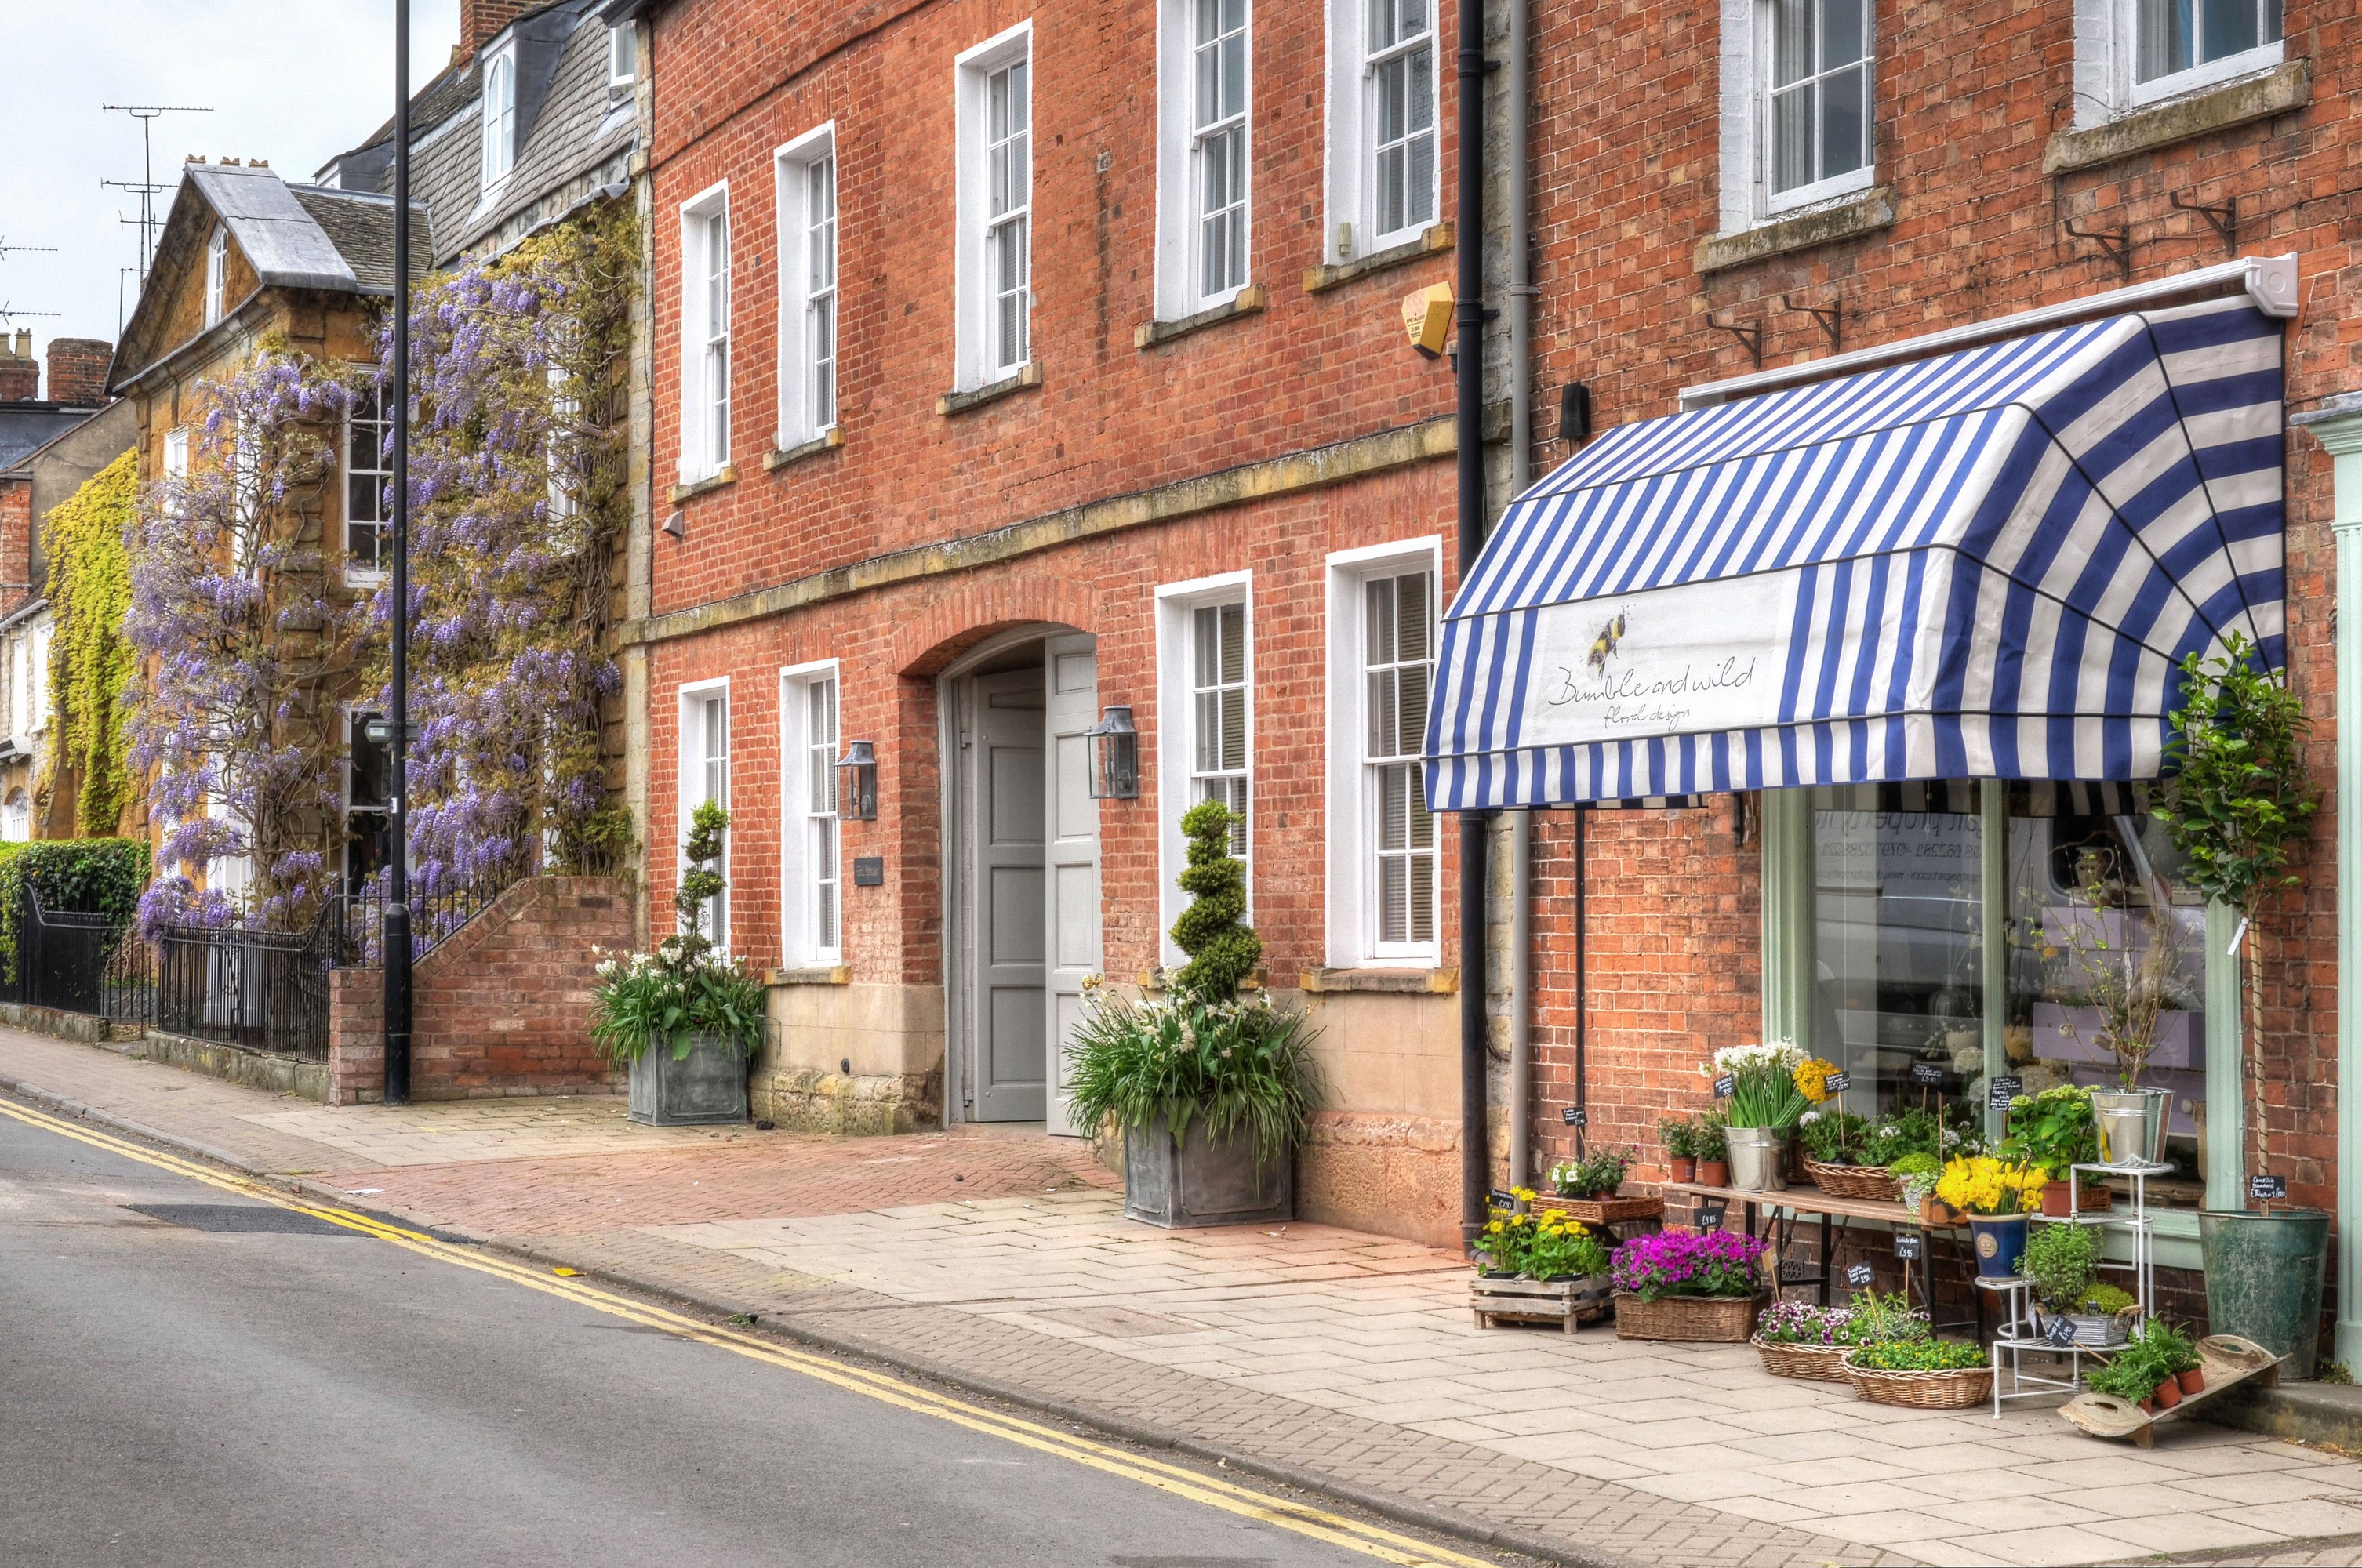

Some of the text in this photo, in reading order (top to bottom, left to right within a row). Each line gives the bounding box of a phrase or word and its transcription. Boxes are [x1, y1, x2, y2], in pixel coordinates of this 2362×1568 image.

[1548, 656, 1756, 706] Bumble and wild
[1604, 703, 1690, 731] floral design
